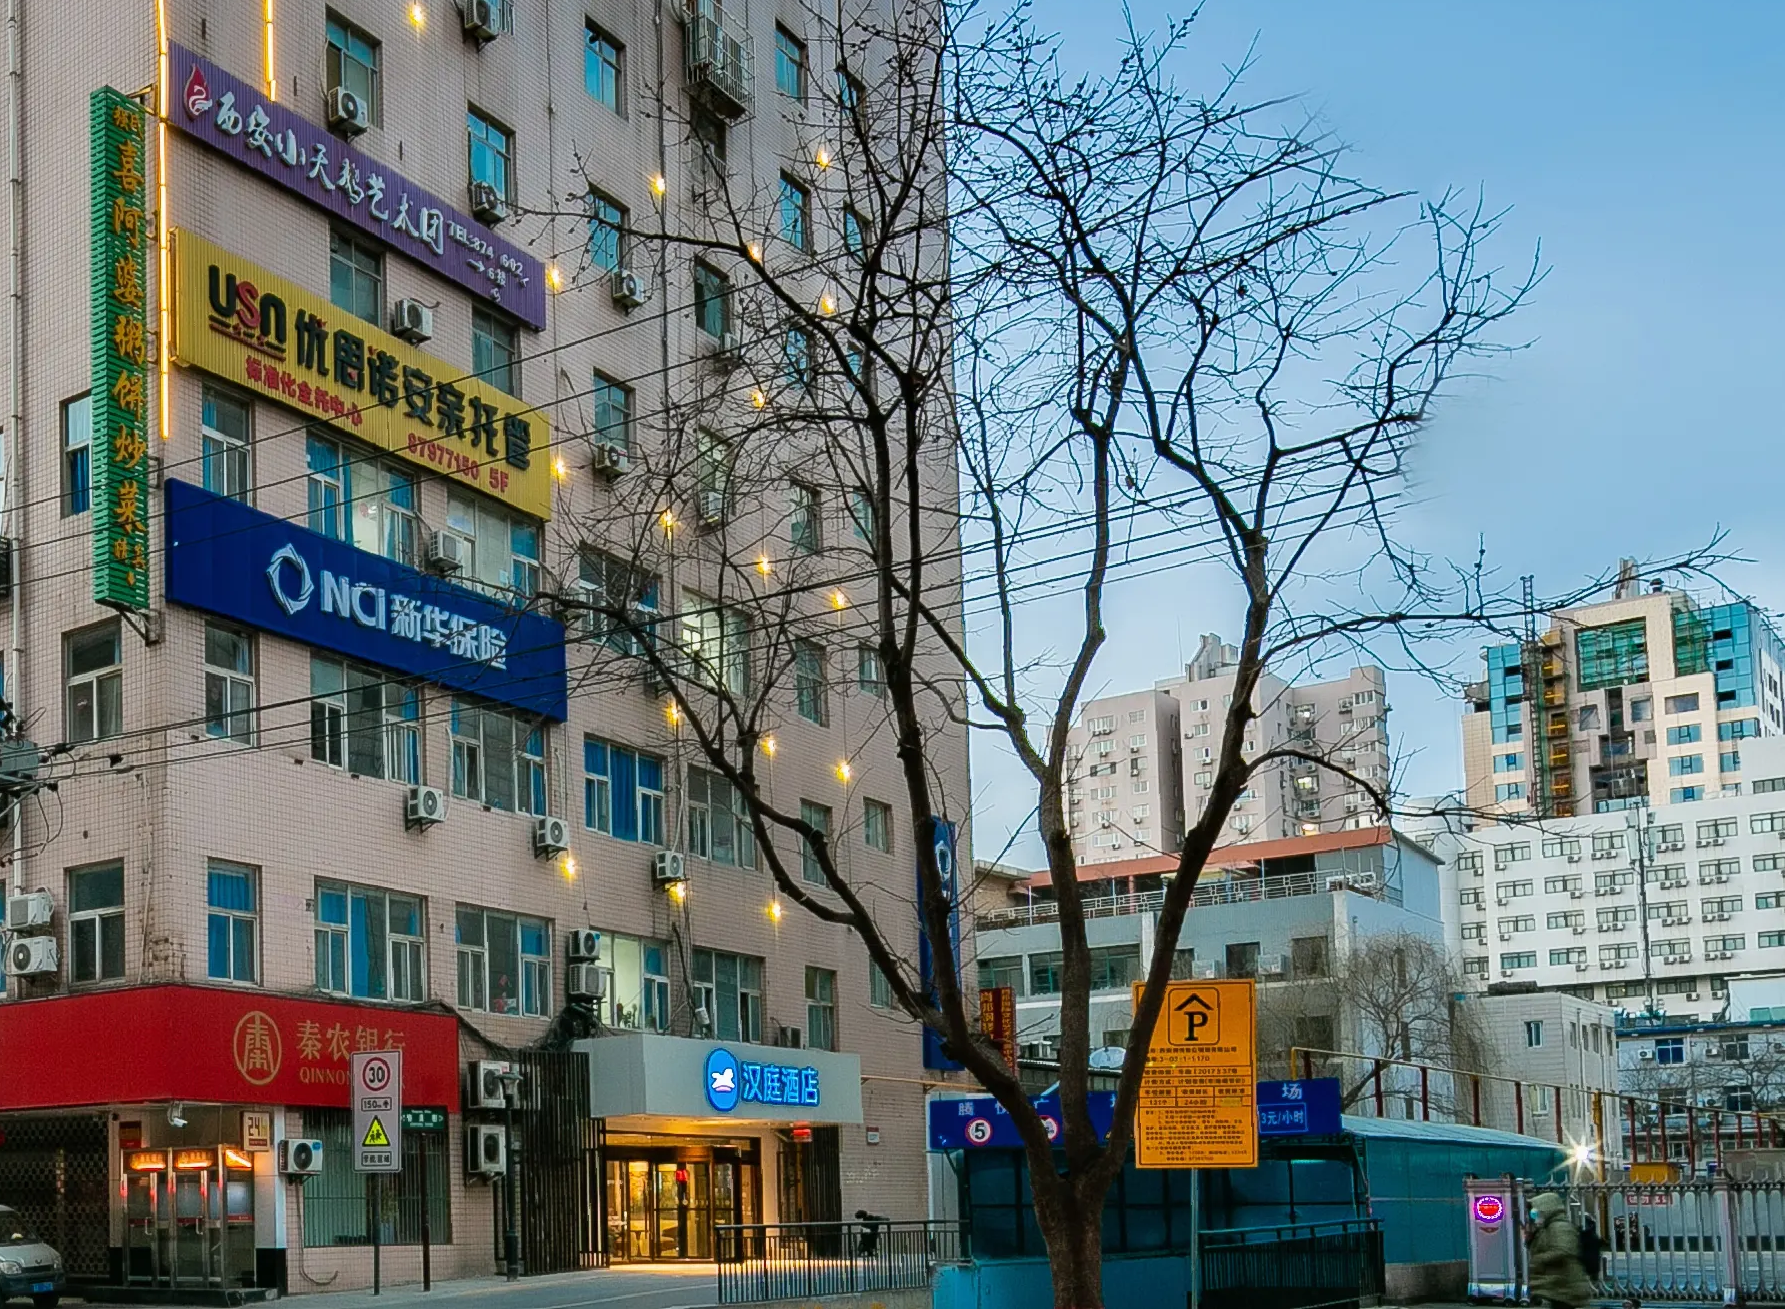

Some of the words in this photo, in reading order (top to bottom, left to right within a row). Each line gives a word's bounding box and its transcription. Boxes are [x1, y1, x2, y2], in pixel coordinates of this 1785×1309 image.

[216, 91, 444, 255] 西安小天鹅艺术团
[246, 354, 363, 427] 标准化全托中心
[295, 307, 531, 471] 优思诺安亲托管
[408, 432, 480, 480] 87977150
[489, 466, 509, 493] 5F
[320, 570, 386, 630] NCI
[390, 594, 507, 670] 新华保险
[1184, 1011, 1209, 1041] P
[368, 1065, 386, 1084] 30
[742, 1062, 819, 1104] 汉庭酒店
[974, 1122, 986, 1140] 5
[1261, 1110, 1305, 1125] 3元/小时
